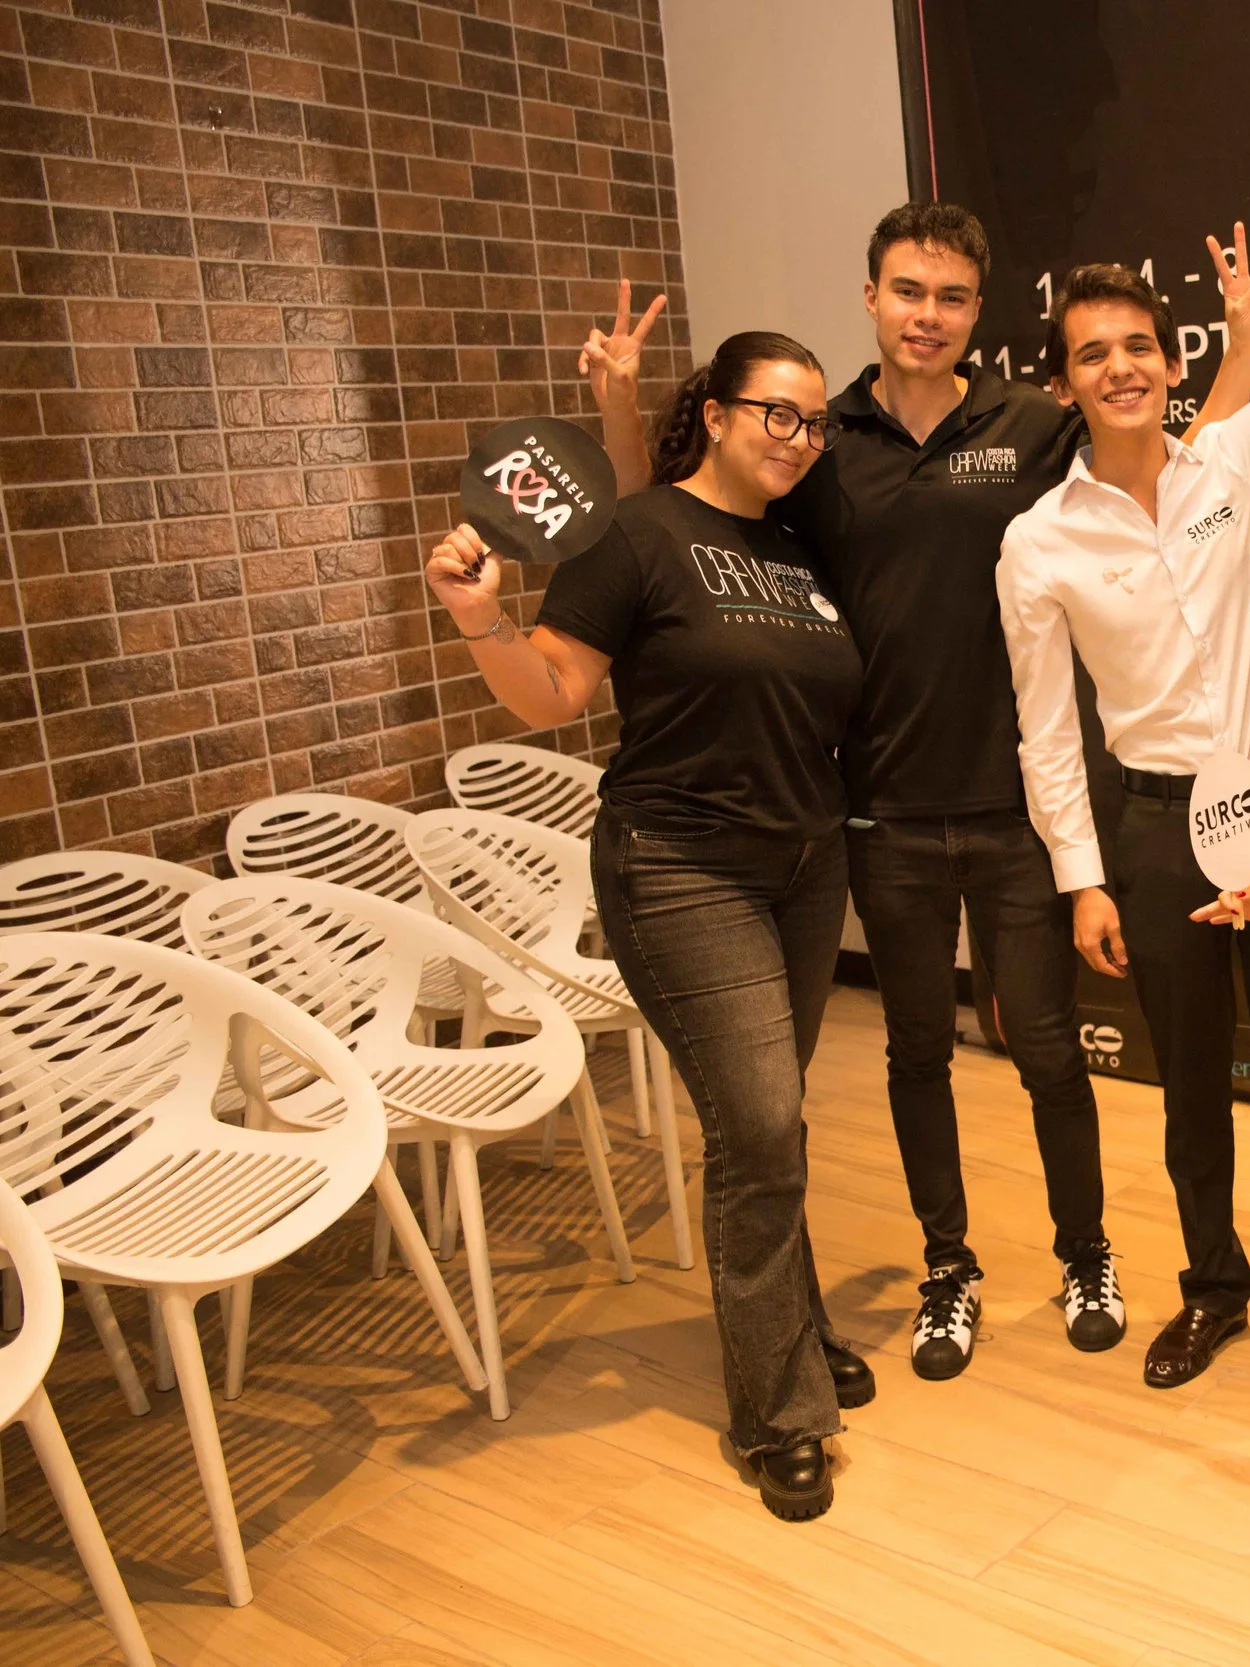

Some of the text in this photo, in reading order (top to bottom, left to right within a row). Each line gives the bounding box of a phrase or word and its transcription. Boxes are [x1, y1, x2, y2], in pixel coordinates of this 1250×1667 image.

[524, 436, 594, 514] PASARELA
[1187, 506, 1233, 539] SURCO
[723, 614, 796, 629] FOREVER
